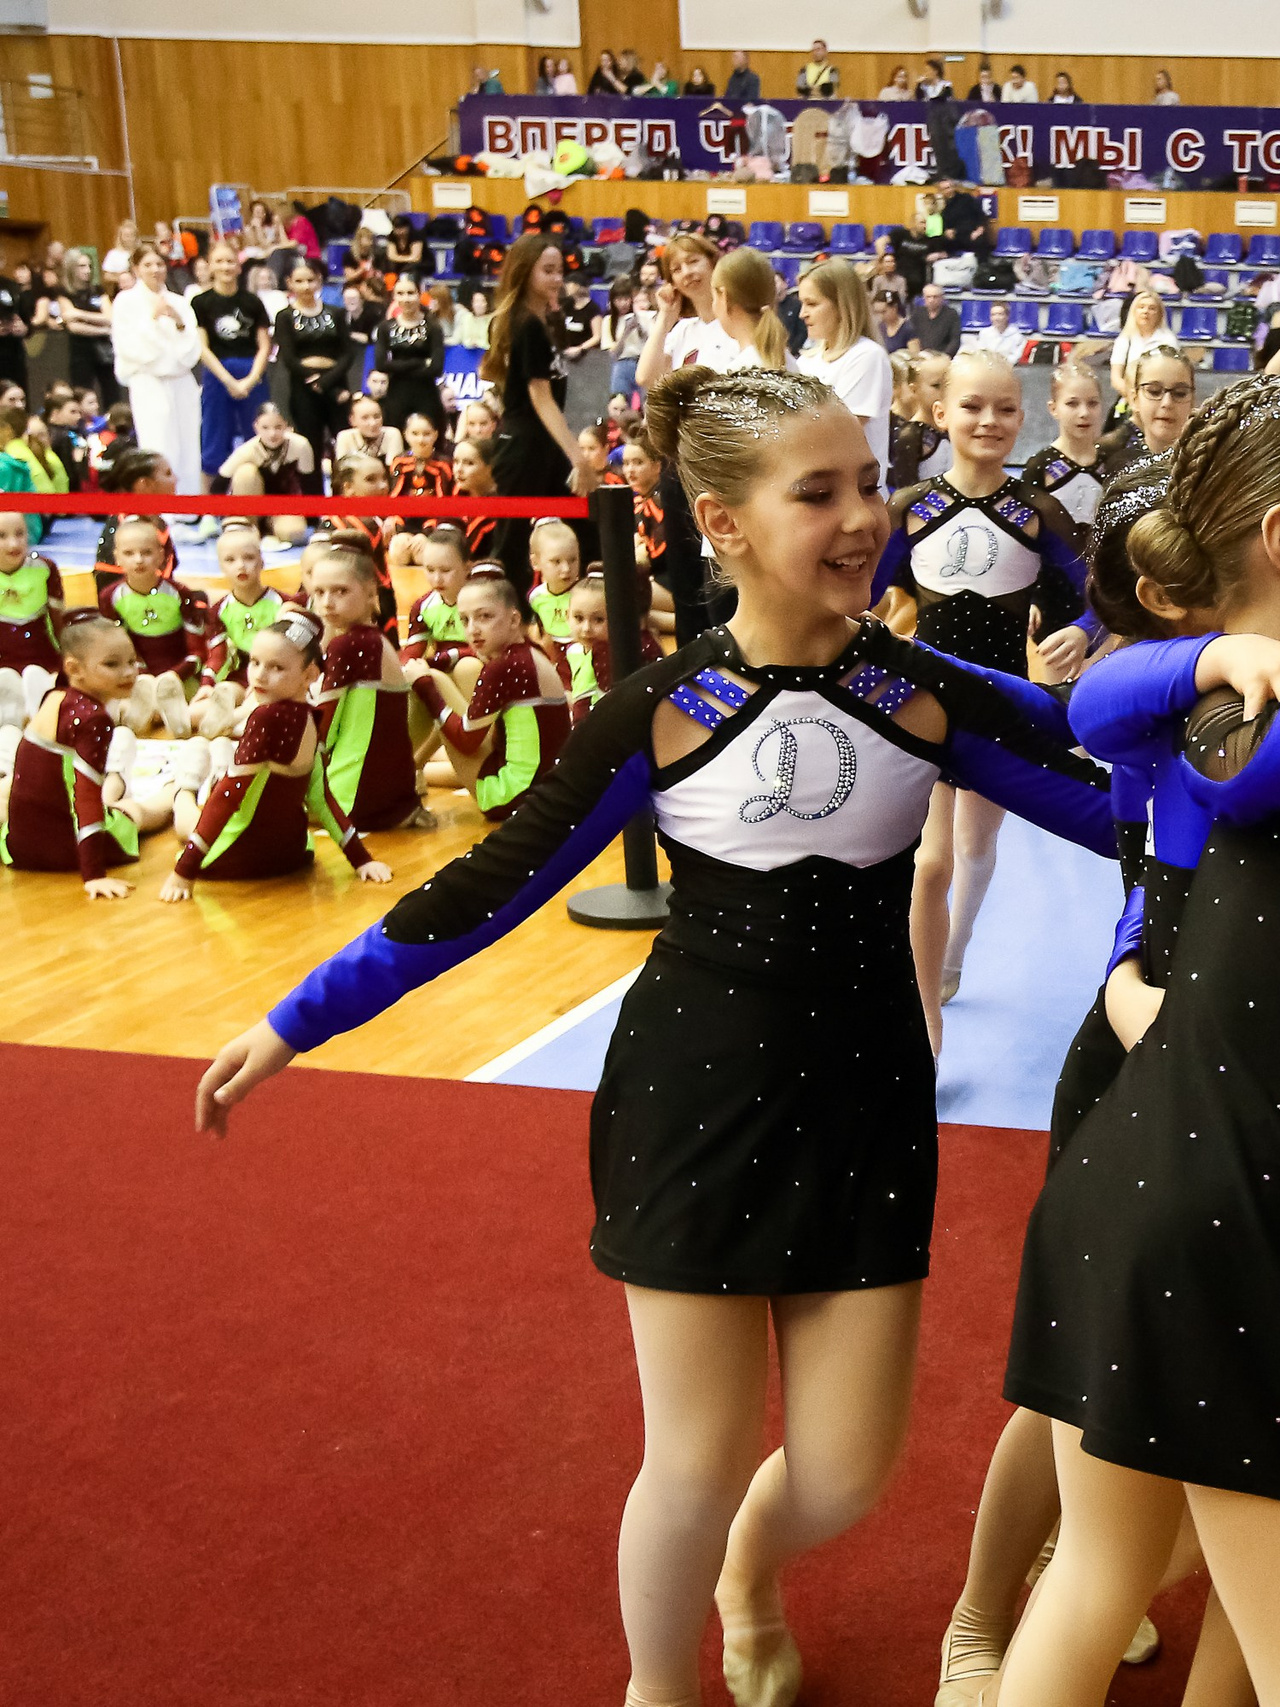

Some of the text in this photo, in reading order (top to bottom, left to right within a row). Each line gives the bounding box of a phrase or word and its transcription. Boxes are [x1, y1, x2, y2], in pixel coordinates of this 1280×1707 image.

[484, 116, 680, 160] ВПЕРЕД
[1050, 126, 1142, 170] МЫ
[1163, 128, 1205, 172] С
